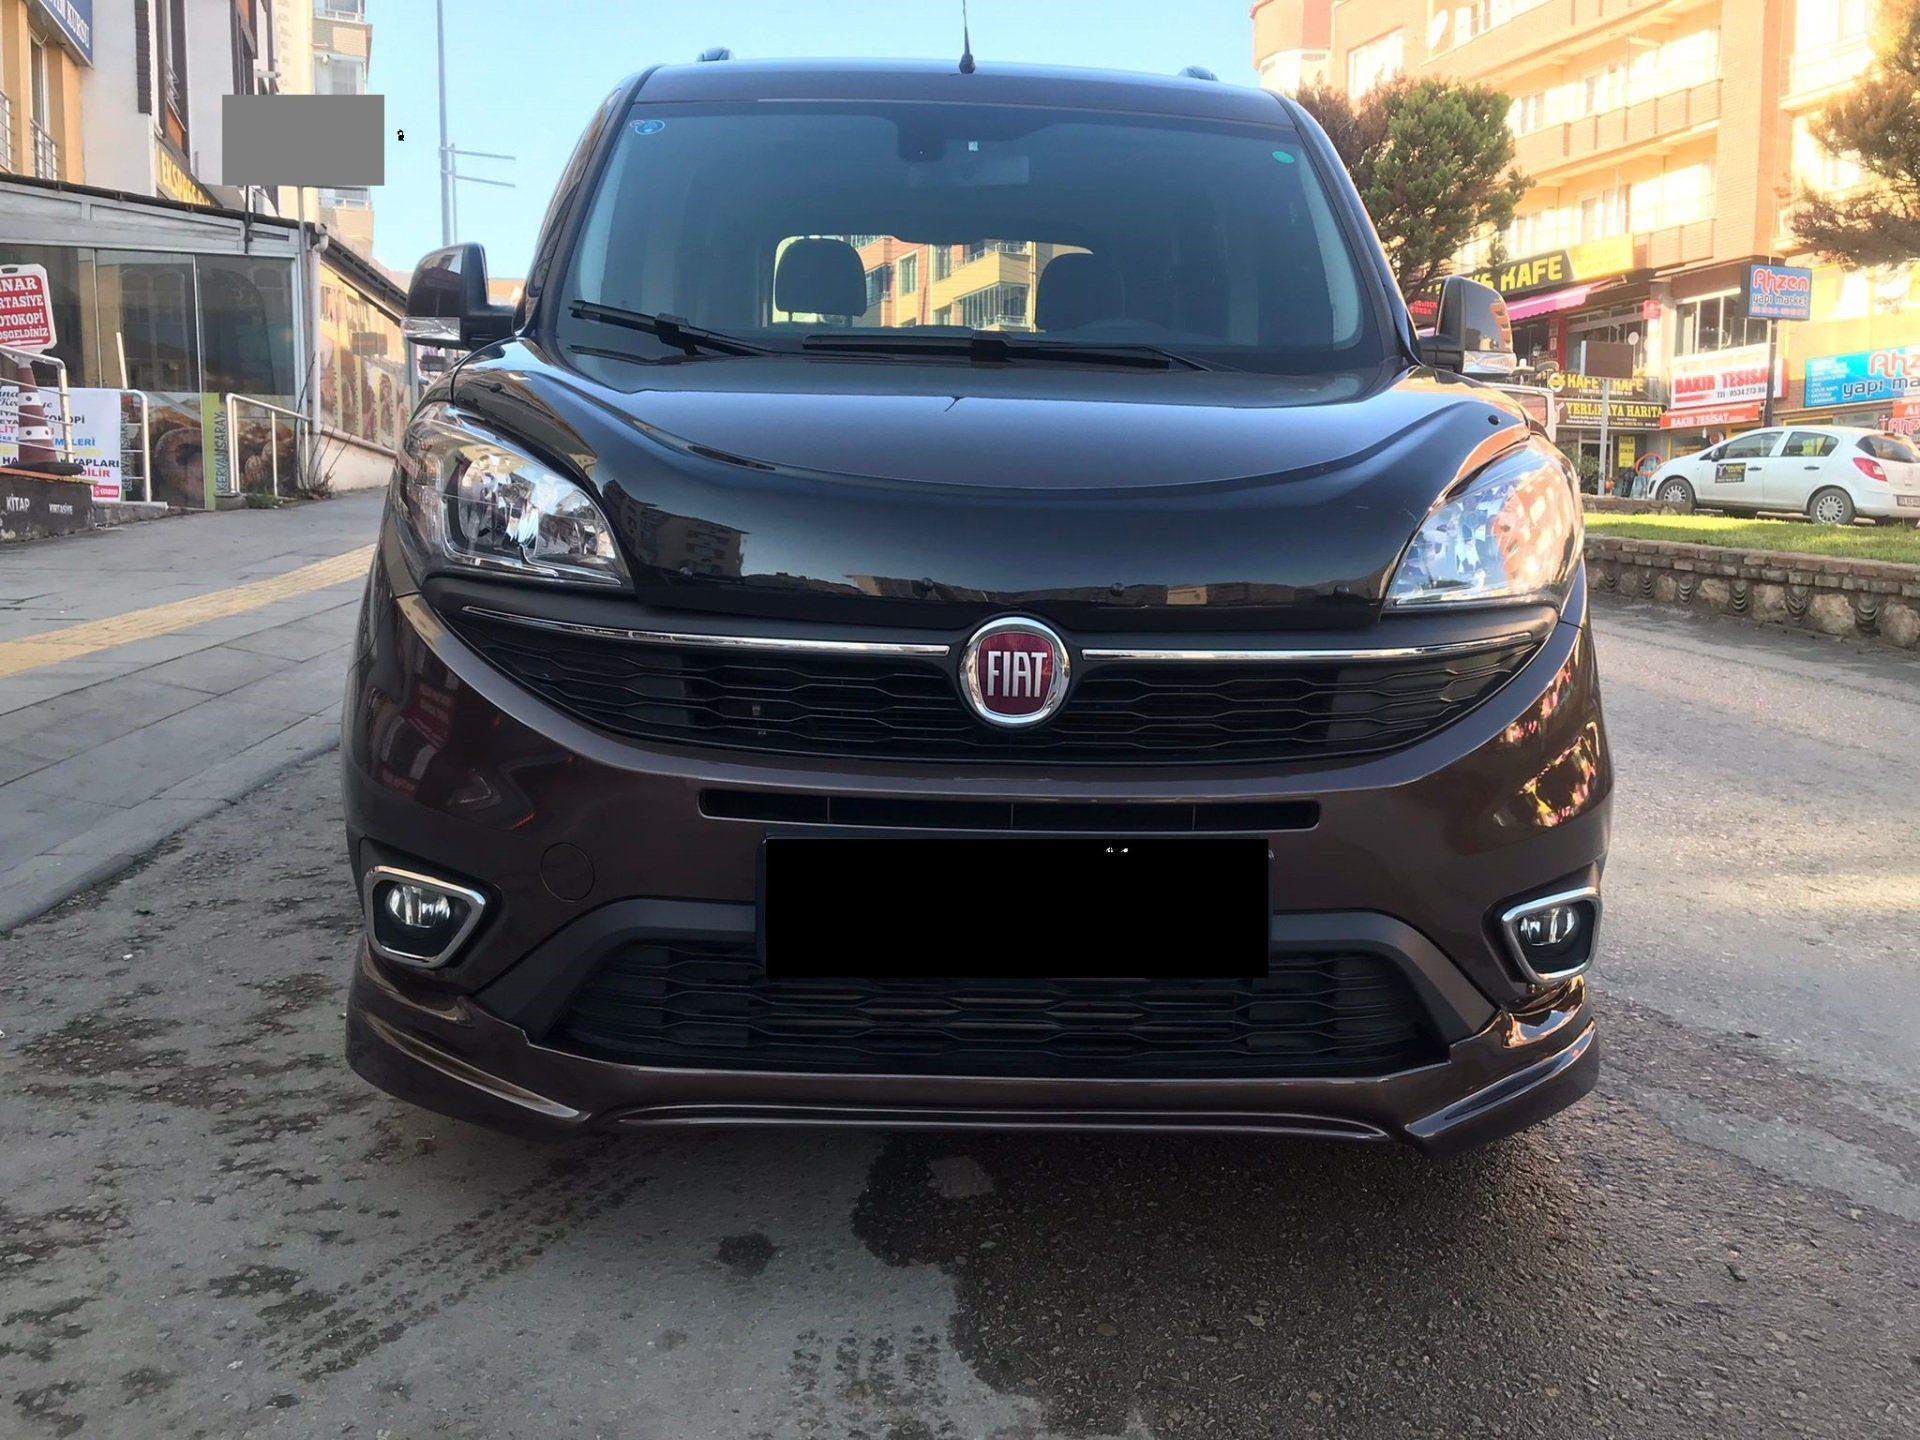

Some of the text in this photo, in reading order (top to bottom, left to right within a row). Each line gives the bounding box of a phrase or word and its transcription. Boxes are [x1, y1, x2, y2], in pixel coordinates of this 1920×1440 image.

[1500, 255, 1563, 292] KAFE
[1753, 268, 1809, 295] Ahzen
[1775, 295, 1809, 305] market
[215, 411, 229, 494] KERVANSARAY
[6, 493, 31, 512] KİTAP
[987, 651, 1048, 698] FIAT
